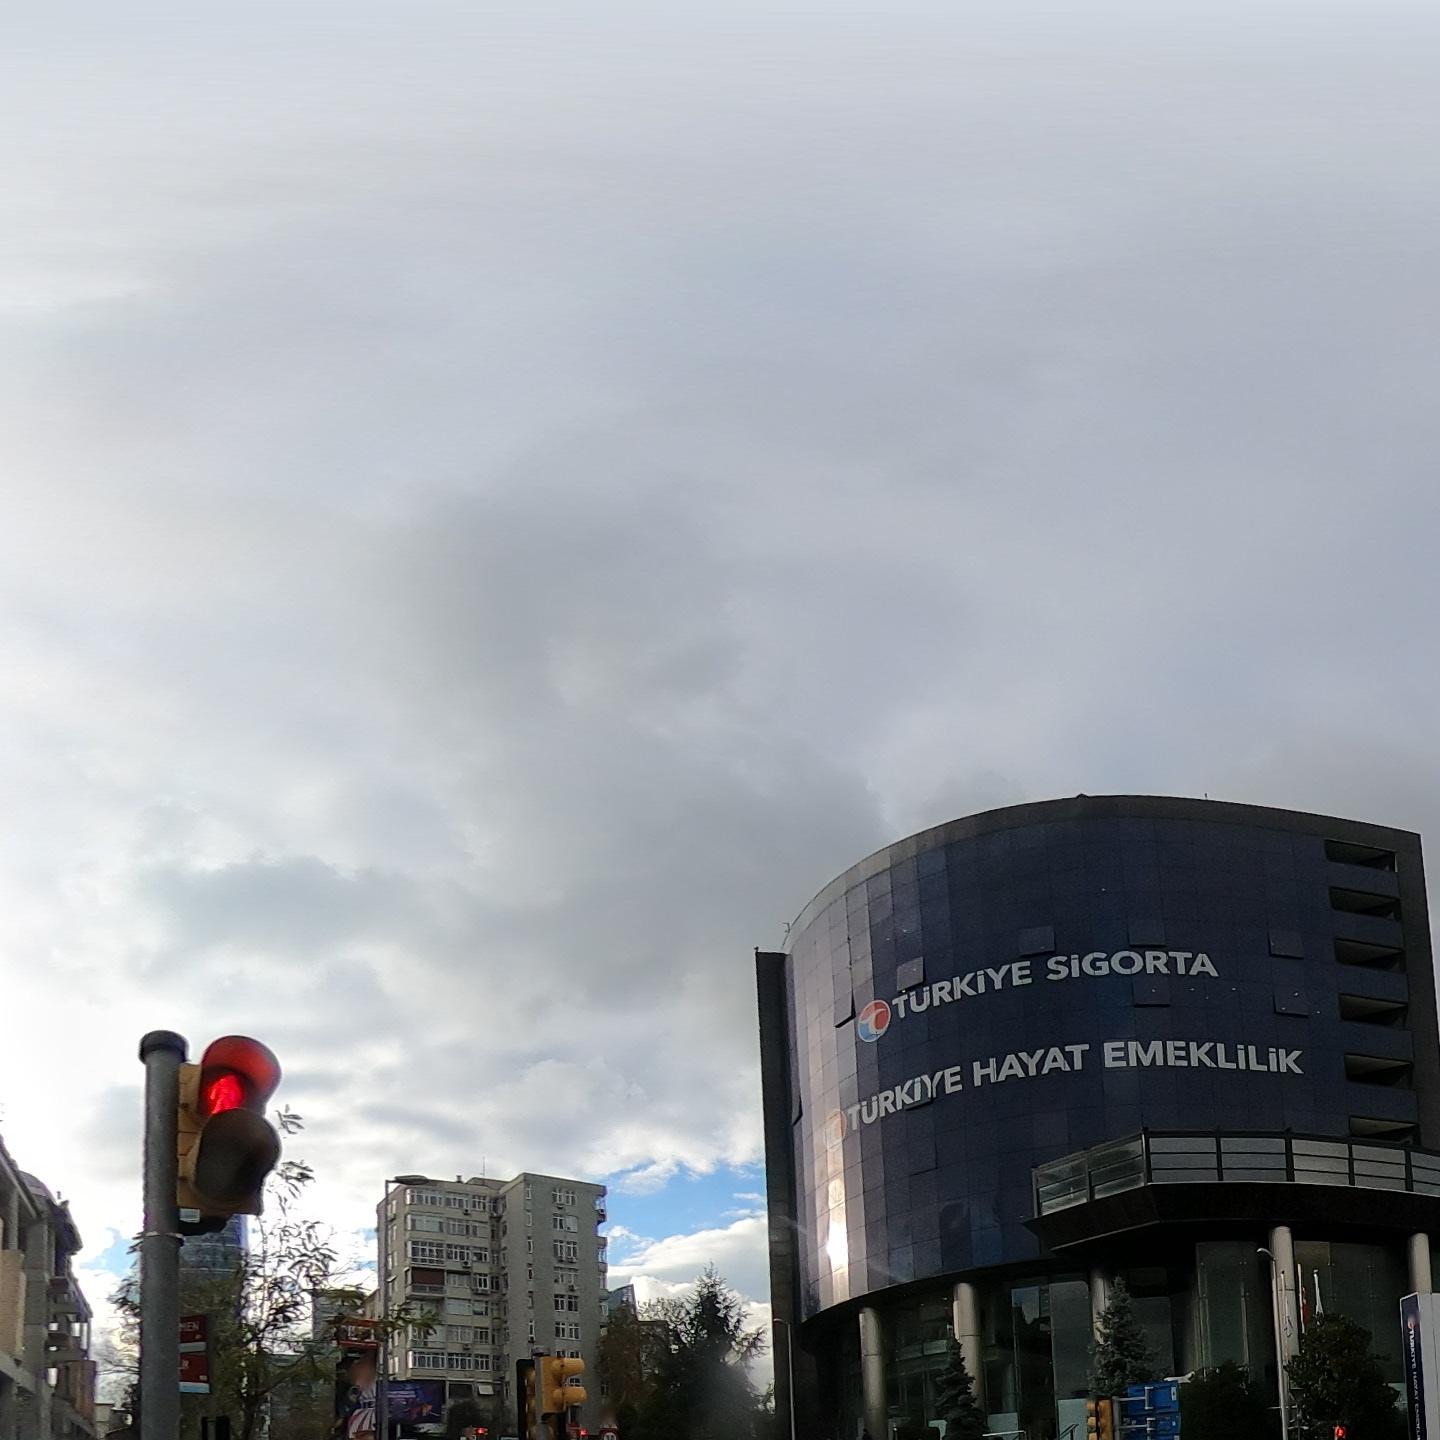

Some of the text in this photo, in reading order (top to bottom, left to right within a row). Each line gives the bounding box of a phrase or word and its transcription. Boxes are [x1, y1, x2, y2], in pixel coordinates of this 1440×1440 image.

[891, 950, 1219, 1019] TÜRKİYE SİGORTA
[973, 1044, 1090, 1087] HAYAT
